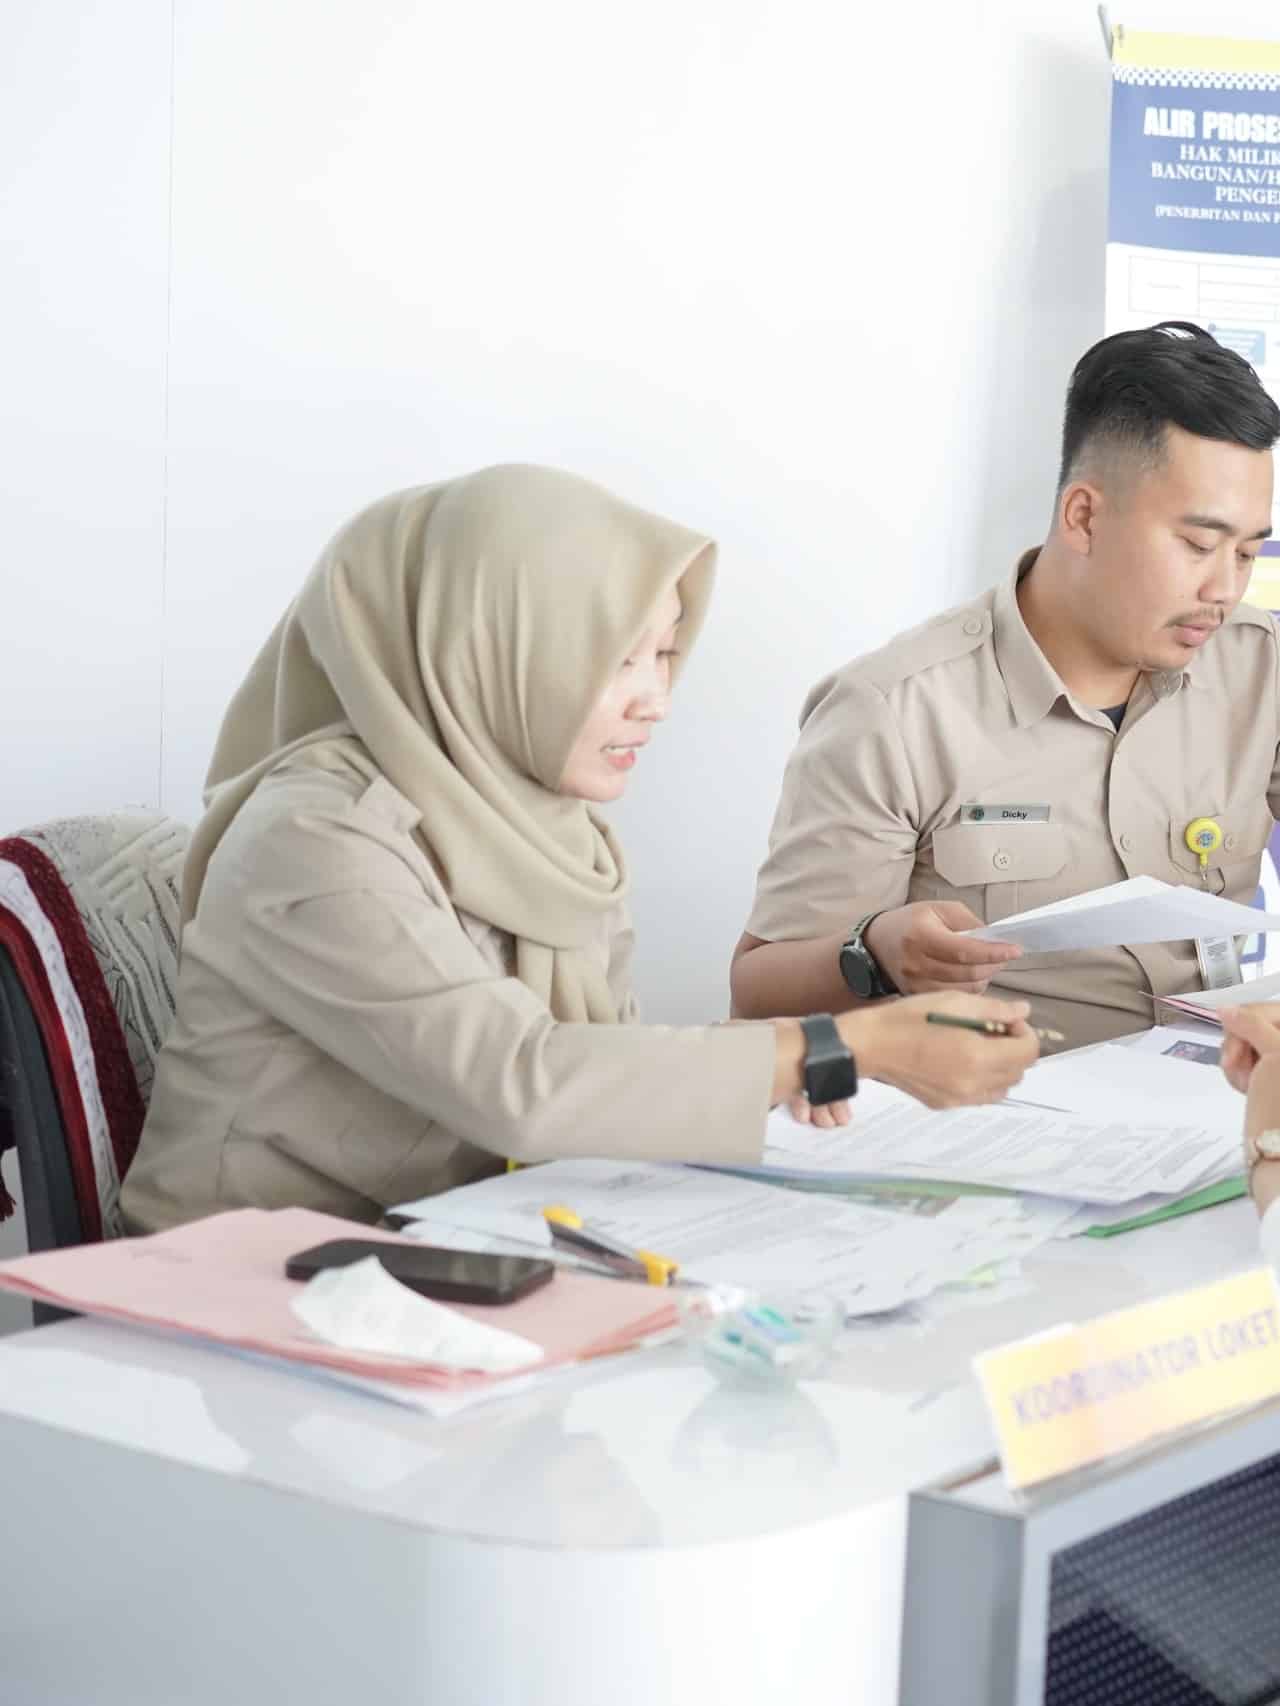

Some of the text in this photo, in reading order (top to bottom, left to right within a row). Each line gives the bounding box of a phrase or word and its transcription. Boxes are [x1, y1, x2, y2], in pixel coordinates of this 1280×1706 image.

[1180, 143, 1222, 163] HAK
[1243, 210, 1270, 223] DAN
[1002, 809, 1028, 820] Dicky
[1013, 1307, 1280, 1428] KOORINATOR LOKET
